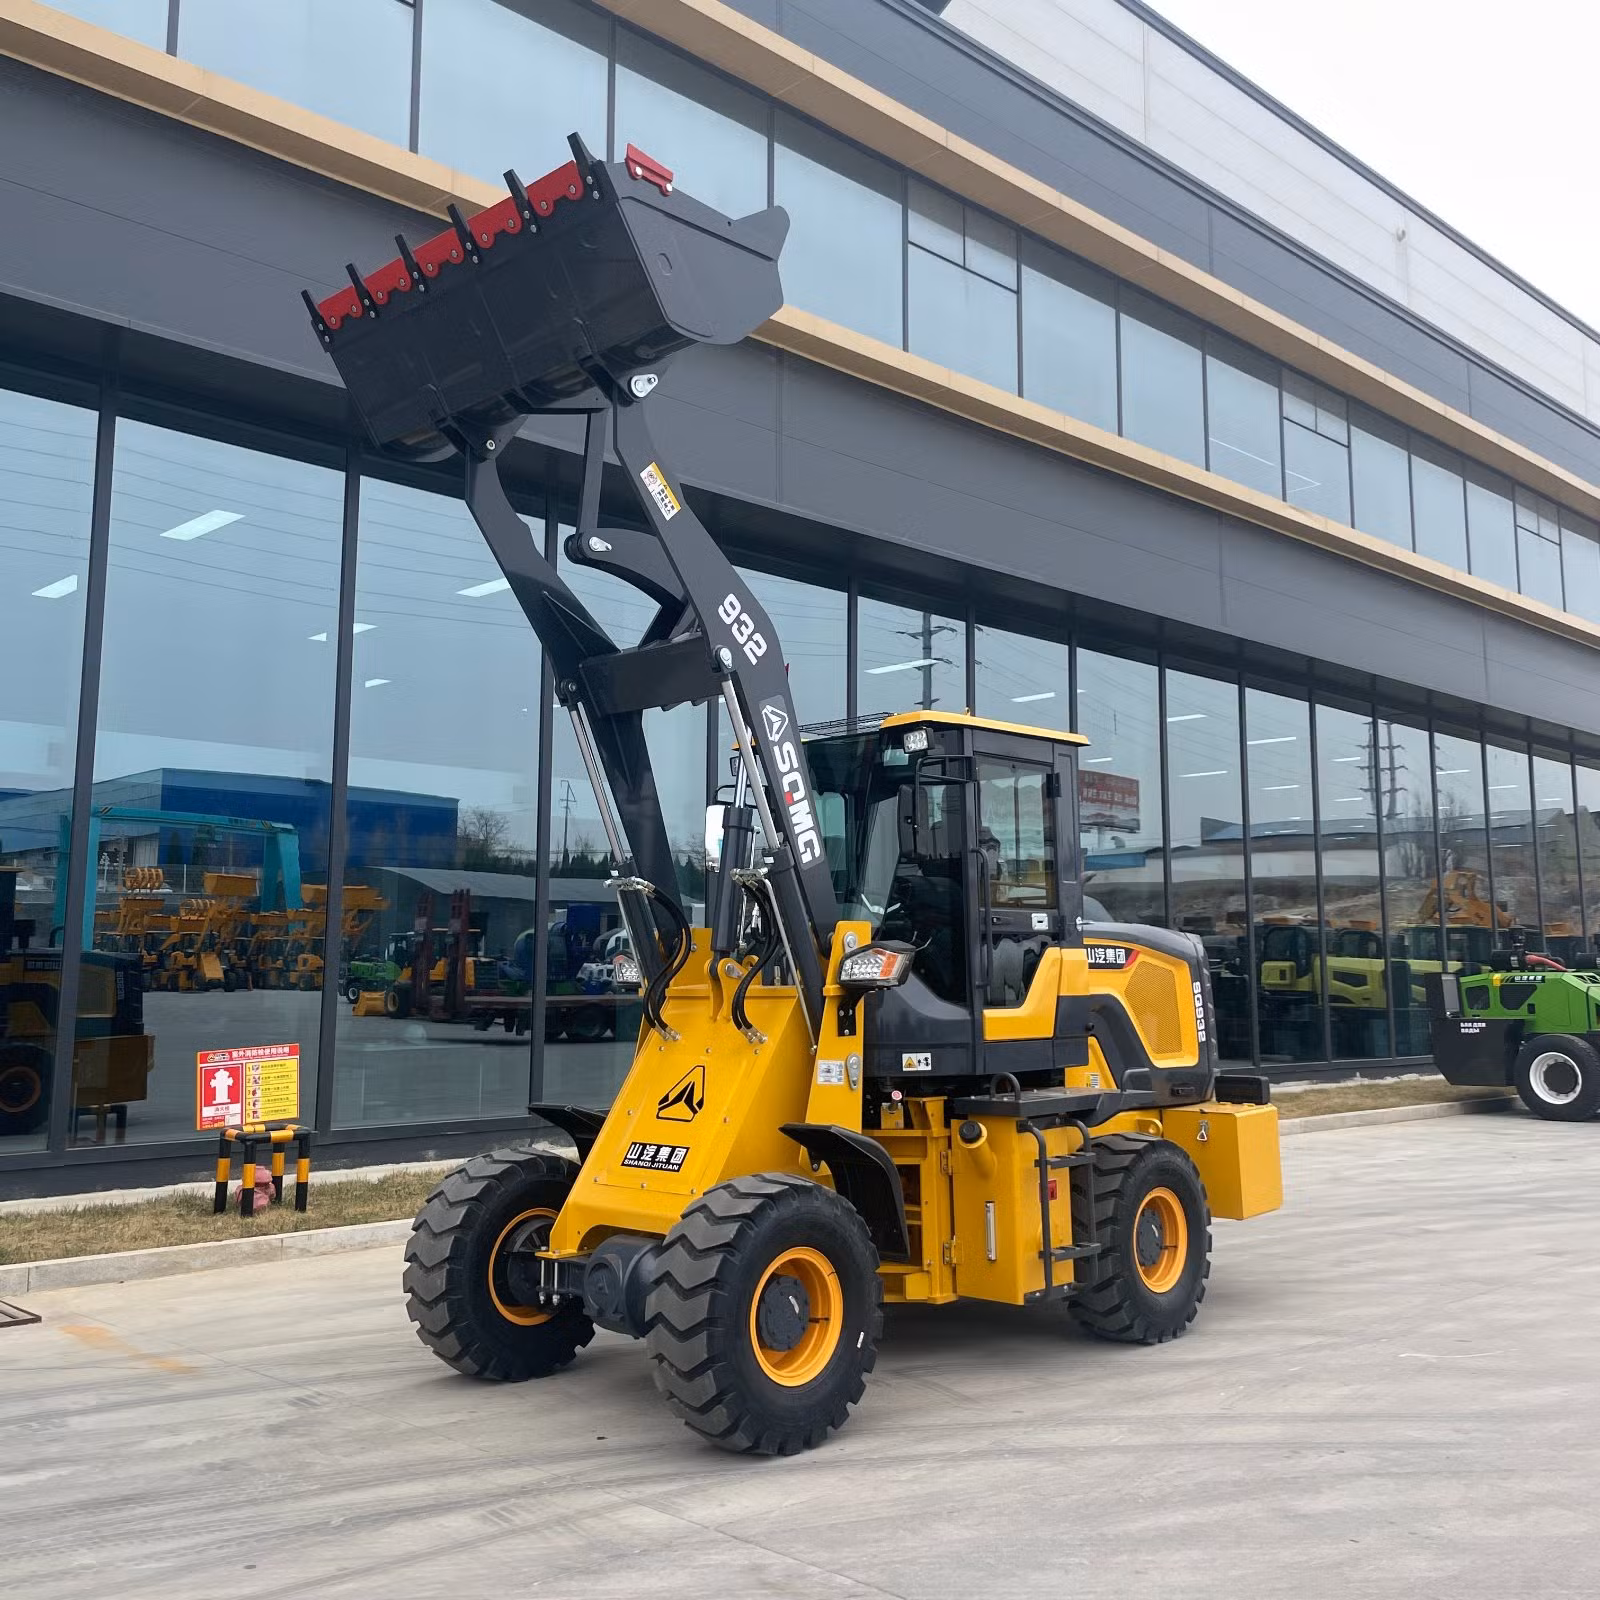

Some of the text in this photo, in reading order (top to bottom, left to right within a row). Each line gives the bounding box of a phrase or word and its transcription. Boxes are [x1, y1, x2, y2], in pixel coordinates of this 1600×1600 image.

[718, 593, 767, 665] 932
[627, 1144, 687, 1163] 山汽集团
[652, 1162, 679, 1170] JITUAN
